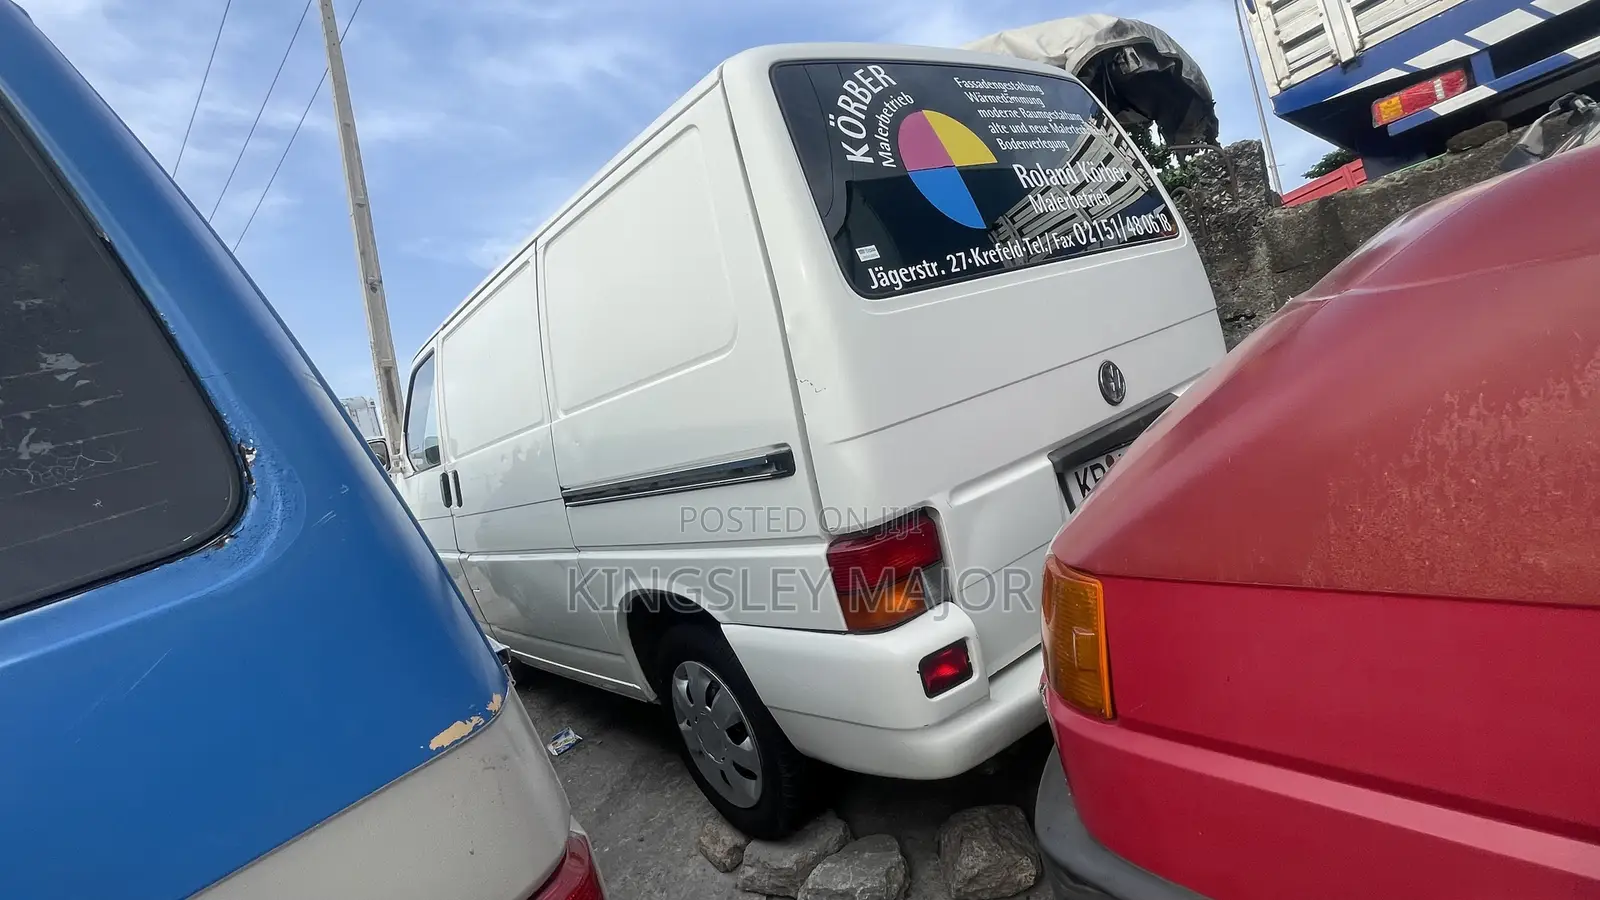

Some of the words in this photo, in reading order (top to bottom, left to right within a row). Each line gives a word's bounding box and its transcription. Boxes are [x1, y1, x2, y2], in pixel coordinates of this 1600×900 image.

[953, 77, 1045, 96] Fassadengestaltung
[828, 64, 898, 164] KÖRBER
[977, 107, 1021, 119] moderne
[1018, 107, 1085, 125] Raumgestaltung
[874, 91, 915, 168] Malerbetrieb
[988, 121, 1010, 134] alte
[1010, 122, 1029, 134] und
[1029, 125, 1052, 134] neue
[995, 137, 1071, 152] Bodenverlegung
[1012, 162, 1079, 189] Roland
[1077, 160, 1129, 183] Körber
[1027, 188, 1112, 214] Malerbetrieb
[867, 259, 946, 291] Jägerstr.
[1051, 232, 1076, 250] Fax
